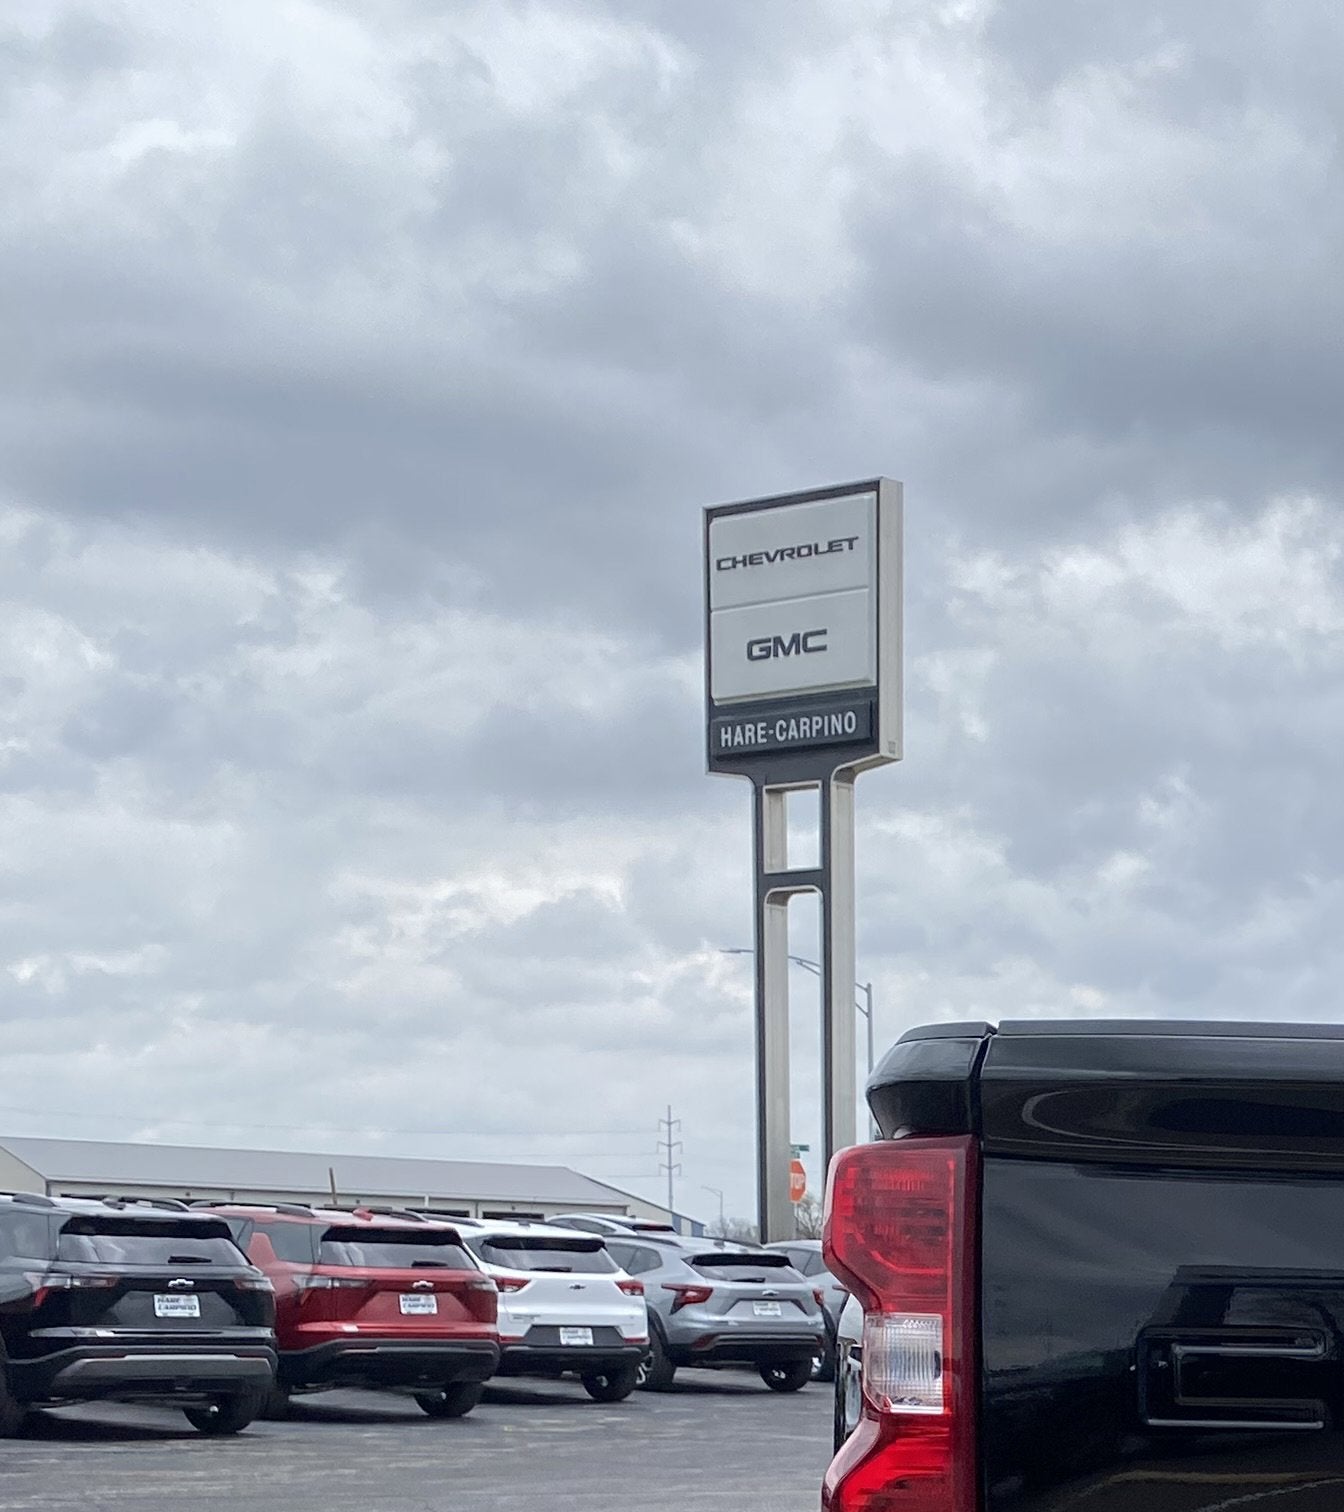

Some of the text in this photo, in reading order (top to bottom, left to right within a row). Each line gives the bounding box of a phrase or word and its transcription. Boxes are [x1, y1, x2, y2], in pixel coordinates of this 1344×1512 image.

[716, 537, 858, 571] CHEVROLET
[746, 629, 827, 661] GMC
[720, 711, 857, 747] HARE-CARPINO
